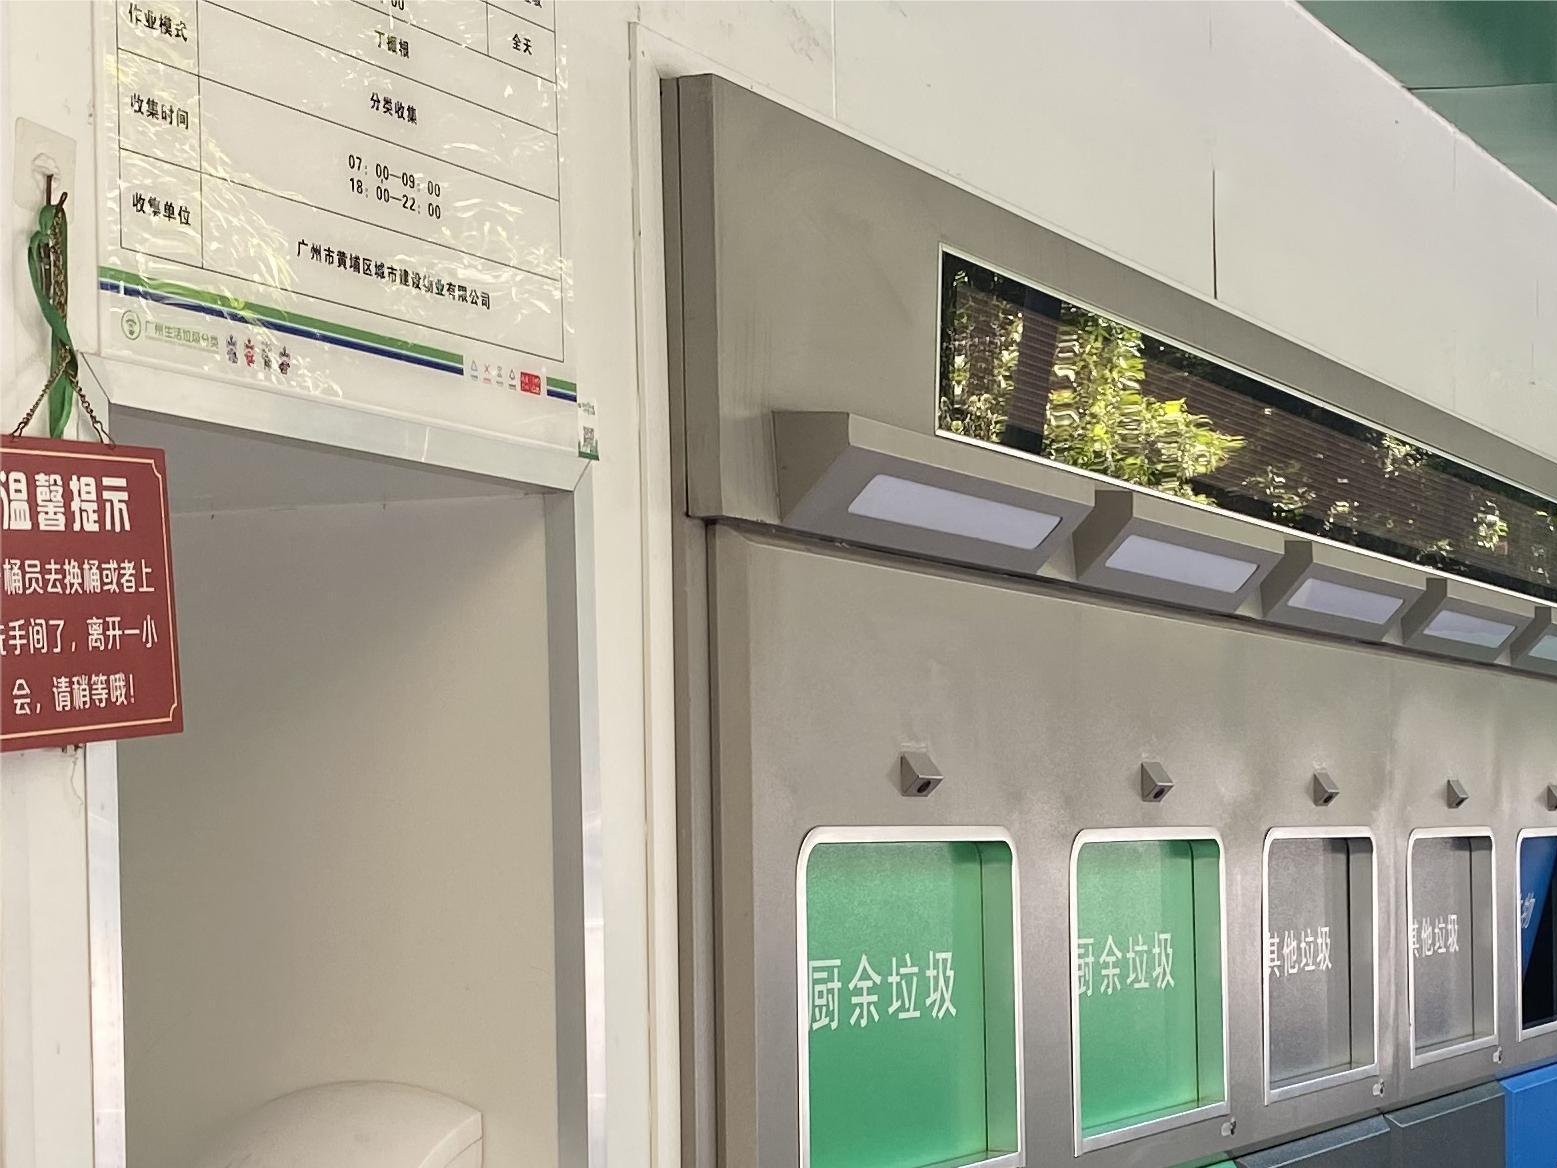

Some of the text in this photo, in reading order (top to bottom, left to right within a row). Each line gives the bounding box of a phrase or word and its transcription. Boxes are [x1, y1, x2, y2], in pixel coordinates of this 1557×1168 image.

[128, 2, 188, 42] 作业模式
[512, 33, 533, 55] 全天
[130, 92, 189, 130] 收集时间
[370, 91, 418, 125] 分类收集
[0, 470, 131, 532] 温馨提示
[3, 558, 155, 595] 桶员去换桶或者上
[1077, 932, 1175, 998] 厨余垃圾
[1268, 925, 1332, 978] 其他垃圾
[808, 950, 957, 1031] 厨余垃圾
